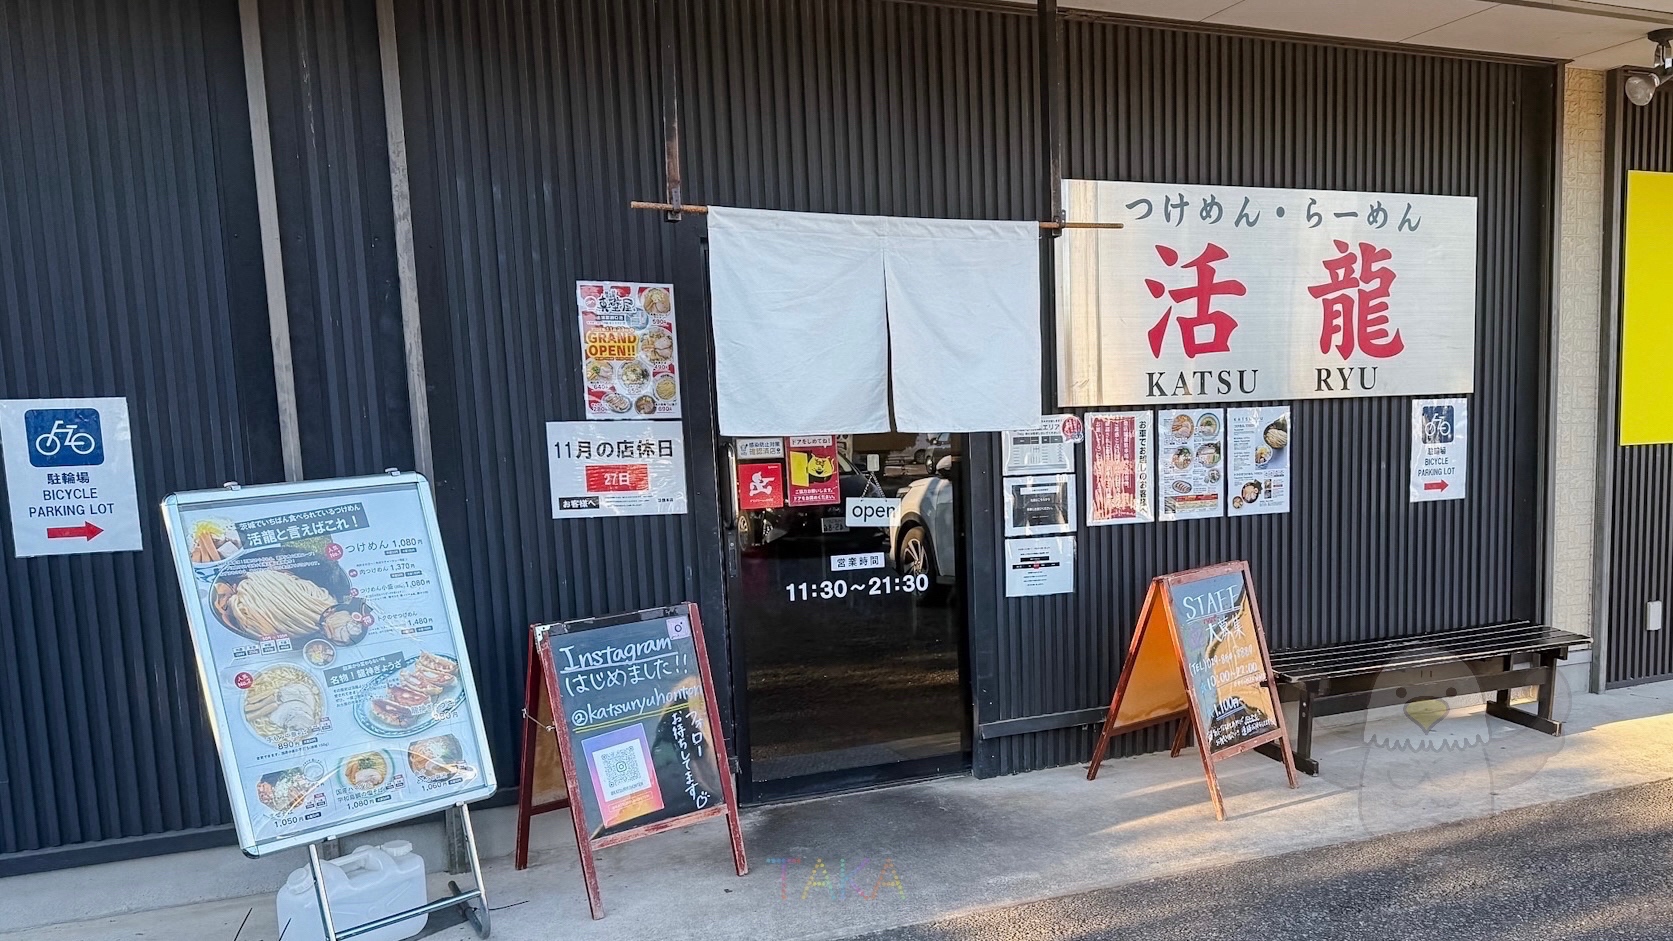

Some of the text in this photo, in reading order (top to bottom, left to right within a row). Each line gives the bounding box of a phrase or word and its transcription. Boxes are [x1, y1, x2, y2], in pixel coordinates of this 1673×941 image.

[1125, 192, 1422, 232] つけめん・らーめん
[587, 332, 637, 343] GRAND
[588, 345, 635, 356] OPEN!!
[1146, 366, 1379, 397] KATSU RYU
[555, 439, 673, 459] 11月の店休日
[1424, 457, 1449, 466] BICYCLE
[47, 472, 90, 485] 駐輪場
[604, 473, 630, 486] 27日
[1418, 467, 1455, 477] PARKING LOT
[43, 488, 98, 501] BICYCLE
[29, 503, 115, 518] PARKING LOT
[562, 498, 597, 508] お客様へ
[239, 504, 361, 531] 茨城でいちばん食べられているつけめん
[852, 504, 895, 522] open
[246, 517, 359, 547] 活龍と言えばこれ！
[345, 540, 389, 553] つけめん
[837, 555, 879, 568] 営業時間
[1183, 585, 1239, 619] STAFF
[1205, 612, 1247, 643] 大募集
[559, 637, 672, 672] Instagram
[565, 654, 688, 696] はじめました!!
[671, 711, 698, 800] お待ちしてます
